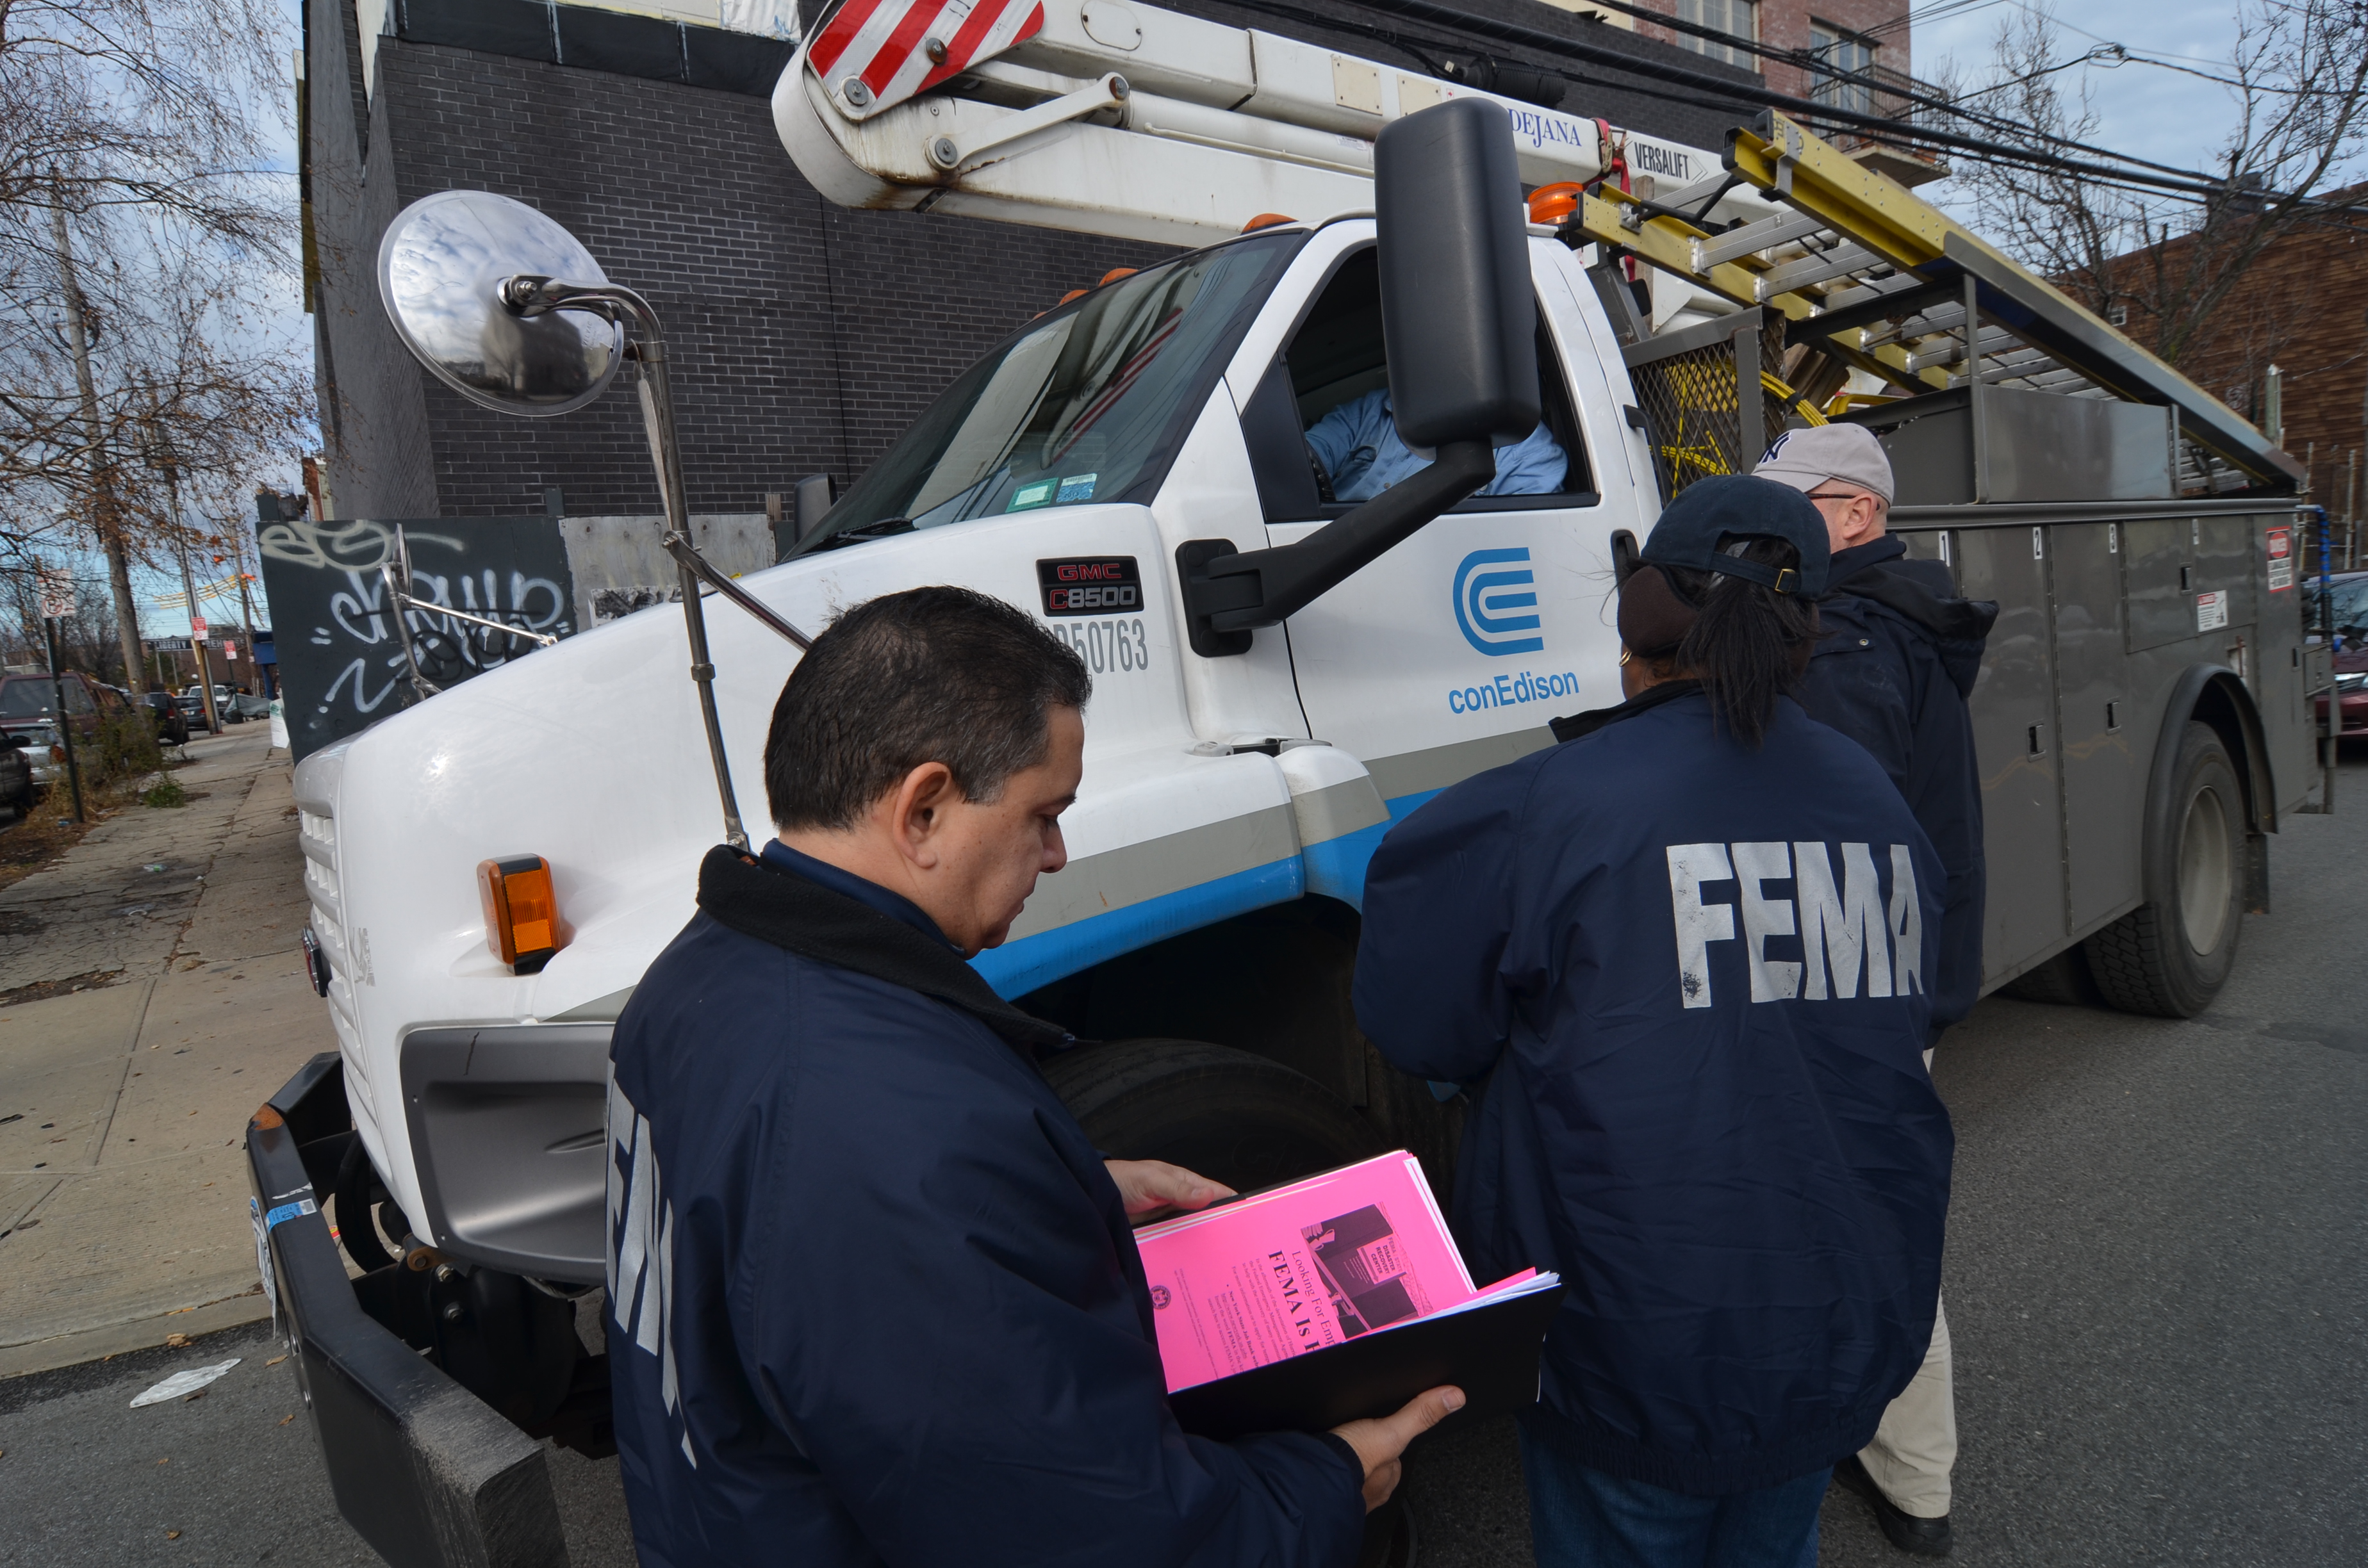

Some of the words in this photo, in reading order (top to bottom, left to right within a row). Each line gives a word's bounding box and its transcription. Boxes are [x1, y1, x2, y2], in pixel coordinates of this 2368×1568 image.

[1507, 108, 1582, 148] DEJANA
[1634, 142, 1690, 180] VERSALIFT
[1941, 534, 1947, 563] 1
[2035, 530, 2041, 557] 2
[1057, 563, 1122, 581] GMC
[1049, 585, 1136, 610] C8500
[154, 641, 186, 649] LIBERTY
[1449, 671, 1579, 714] conEdison
[1666, 841, 1923, 1009] FEMA
[1371, 1253, 1383, 1274] CENTER
[1376, 1246, 1390, 1274] RECOVERY
[1383, 1245, 1396, 1271] DISASTER
[1388, 1237, 1397, 1254] FEMA
[1394, 1257, 1403, 1272] STATE
[1268, 1250, 1303, 1314] FEMA
[1295, 1318, 1310, 1336] Is
[1292, 1250, 1315, 1296] Looking
[1311, 1297, 1324, 1316] For
[1239, 1287, 1252, 1314] information
[1251, 1268, 1262, 1285] Federal
[1258, 1285, 1270, 1311] Emergency
[1269, 1311, 1283, 1343] Management
[1255, 1297, 1265, 1318] recovery
[1260, 1271, 1272, 1293] aftermath
[1275, 1307, 1287, 1334] devastation
[1207, 1298, 1216, 1313] search
[1218, 1329, 1226, 1345] access
[1227, 1330, 1236, 1349] FEMA
[1246, 1340, 1254, 1355] Bank
